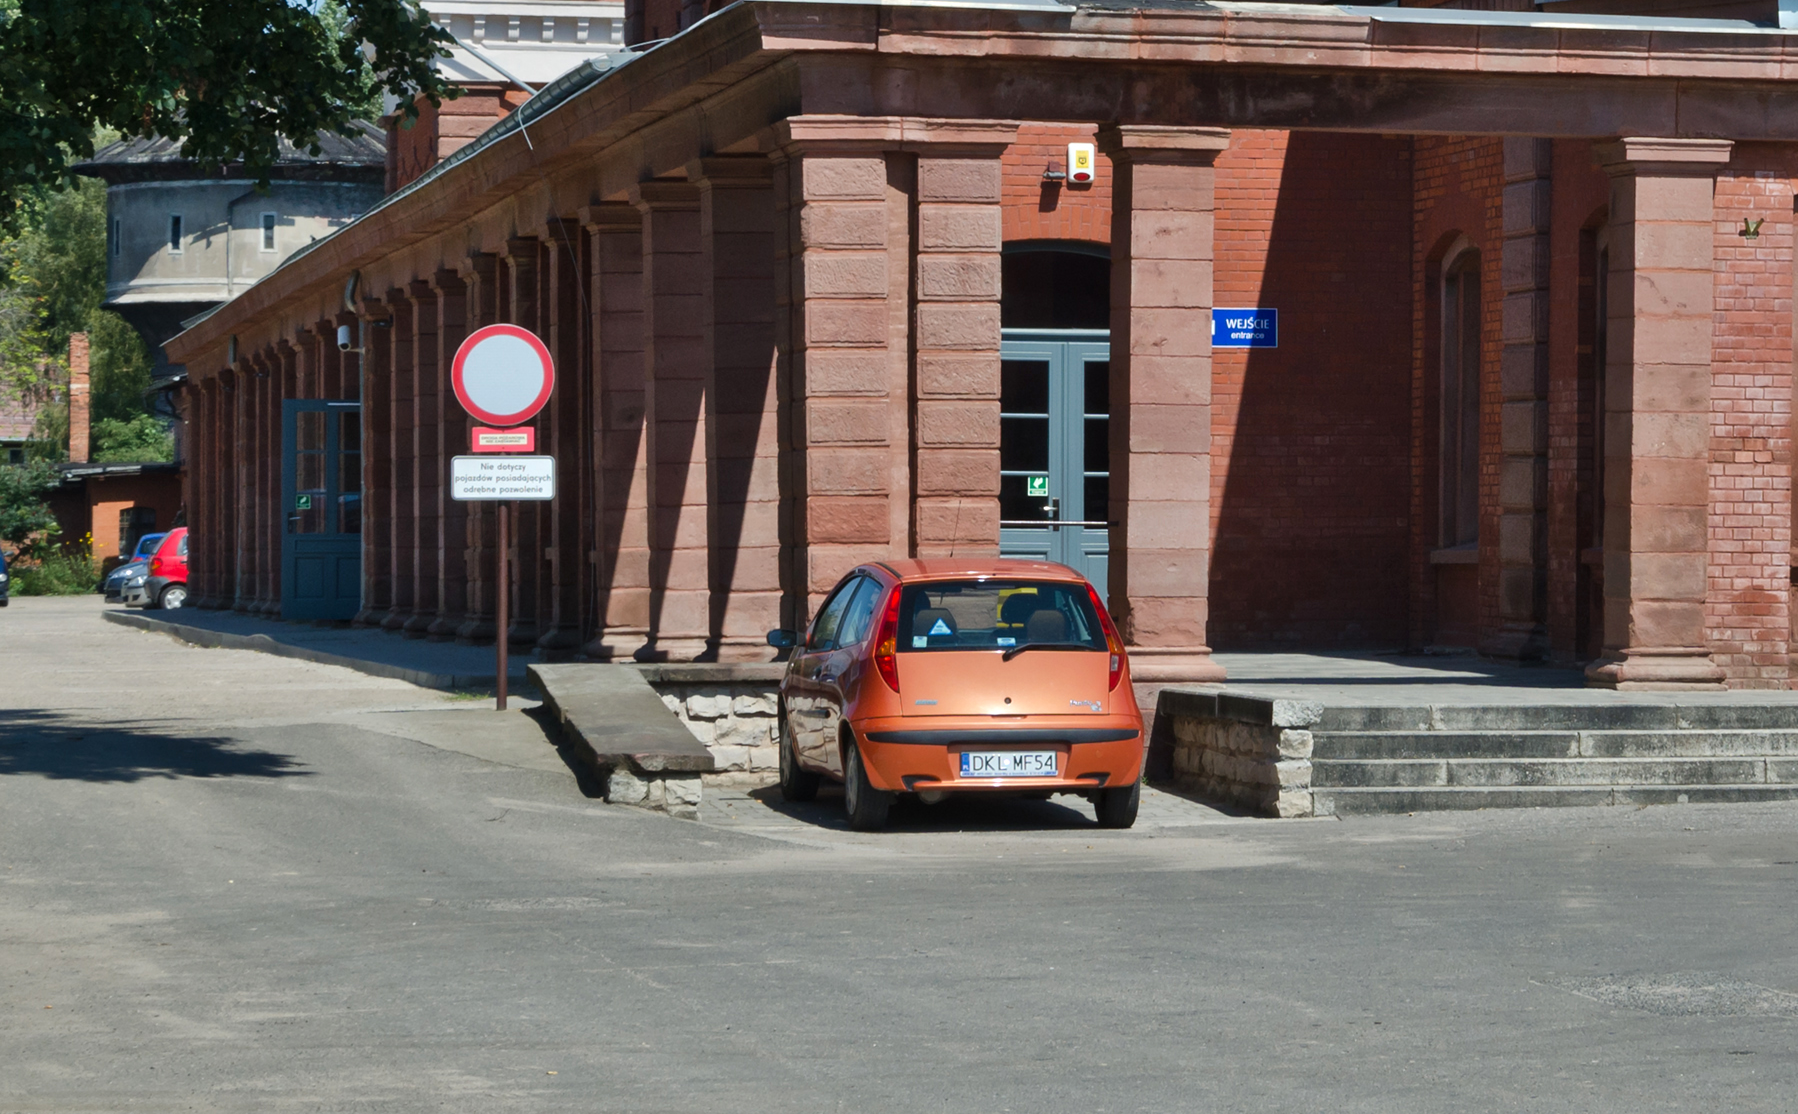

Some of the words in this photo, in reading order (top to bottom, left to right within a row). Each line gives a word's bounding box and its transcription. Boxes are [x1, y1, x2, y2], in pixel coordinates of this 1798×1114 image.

[1225, 316, 1270, 329] WEJŚCIE
[1230, 331, 1265, 339] entrance
[480, 462, 494, 471] Nie
[497, 462, 526, 472] dotyczy
[455, 474, 493, 483] pojazdów
[496, 474, 552, 483] posiadających
[463, 486, 497, 494] odrębne
[499, 486, 543, 495] pozwolenie
[973, 755, 1008, 771] DKL
[1013, 755, 1053, 771] MF54
